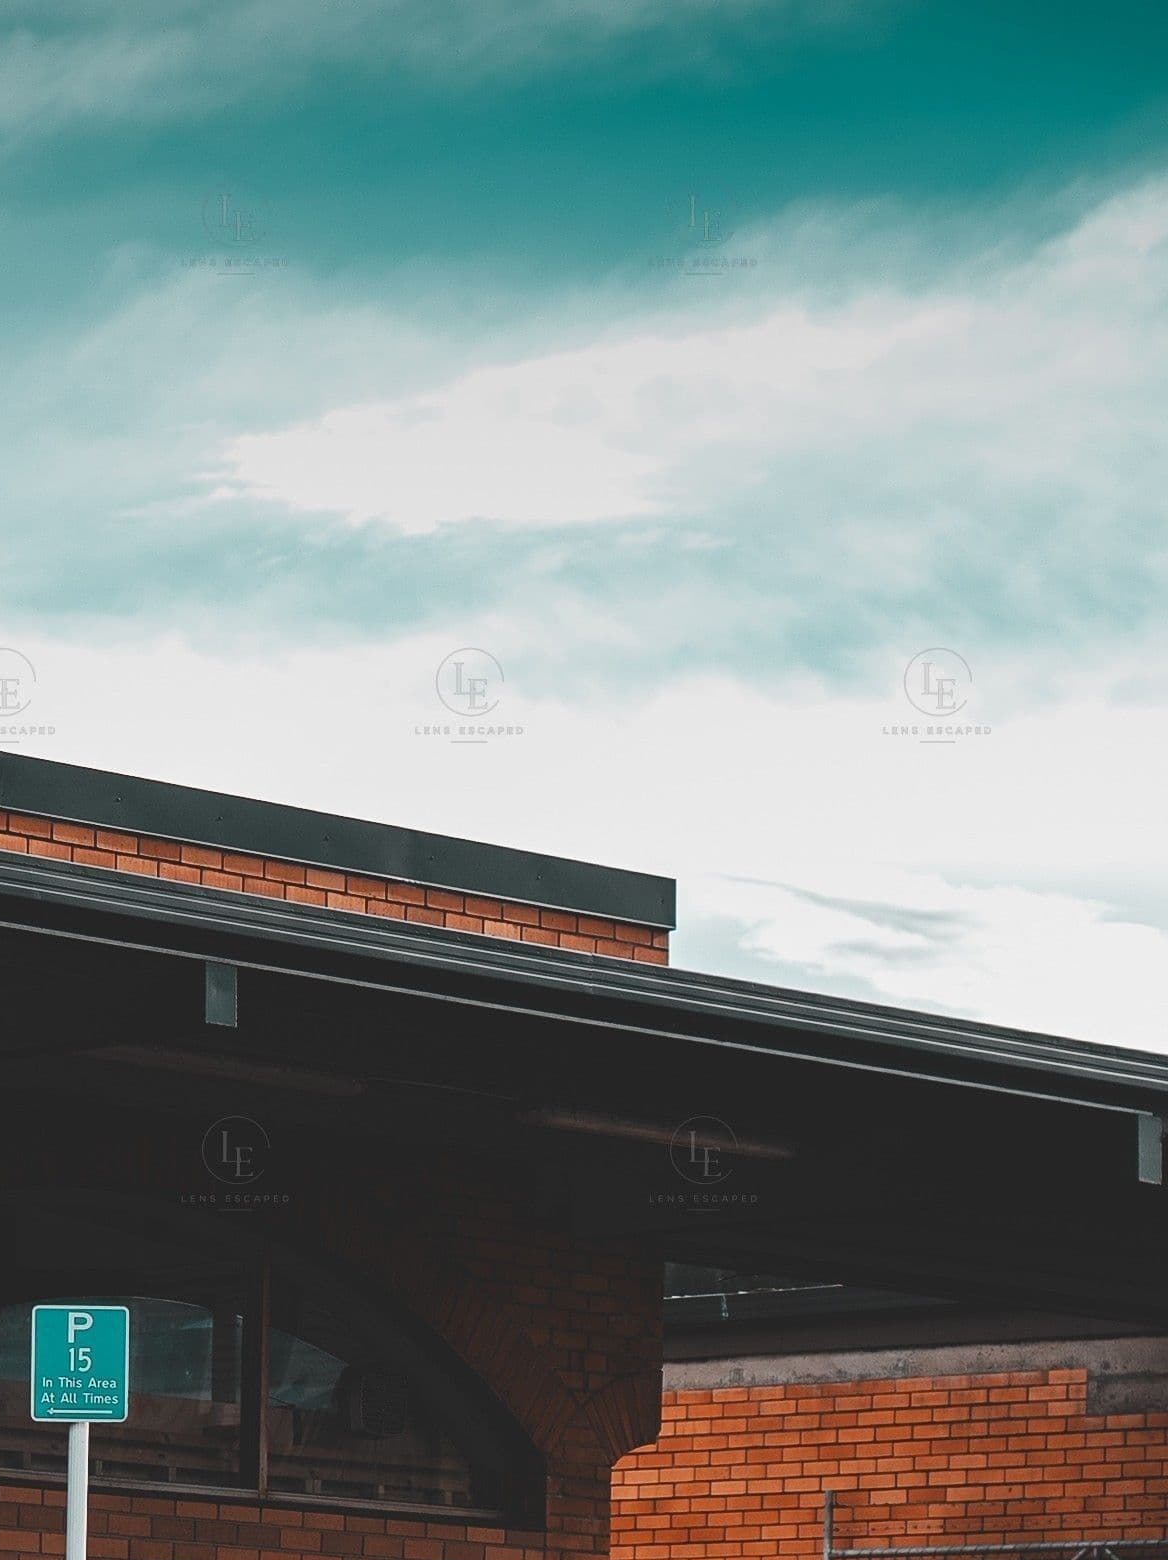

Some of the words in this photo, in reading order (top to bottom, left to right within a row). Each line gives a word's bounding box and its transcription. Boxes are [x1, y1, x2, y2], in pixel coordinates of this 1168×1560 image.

[67, 1311, 94, 1344] P
[68, 1347, 92, 1373] 15
[41, 1376, 53, 1388] In
[58, 1376, 82, 1389] This
[87, 1377, 117, 1389] Area
[40, 1392, 55, 1404] At
[60, 1392, 78, 1404] All
[82, 1392, 119, 1405] Times
